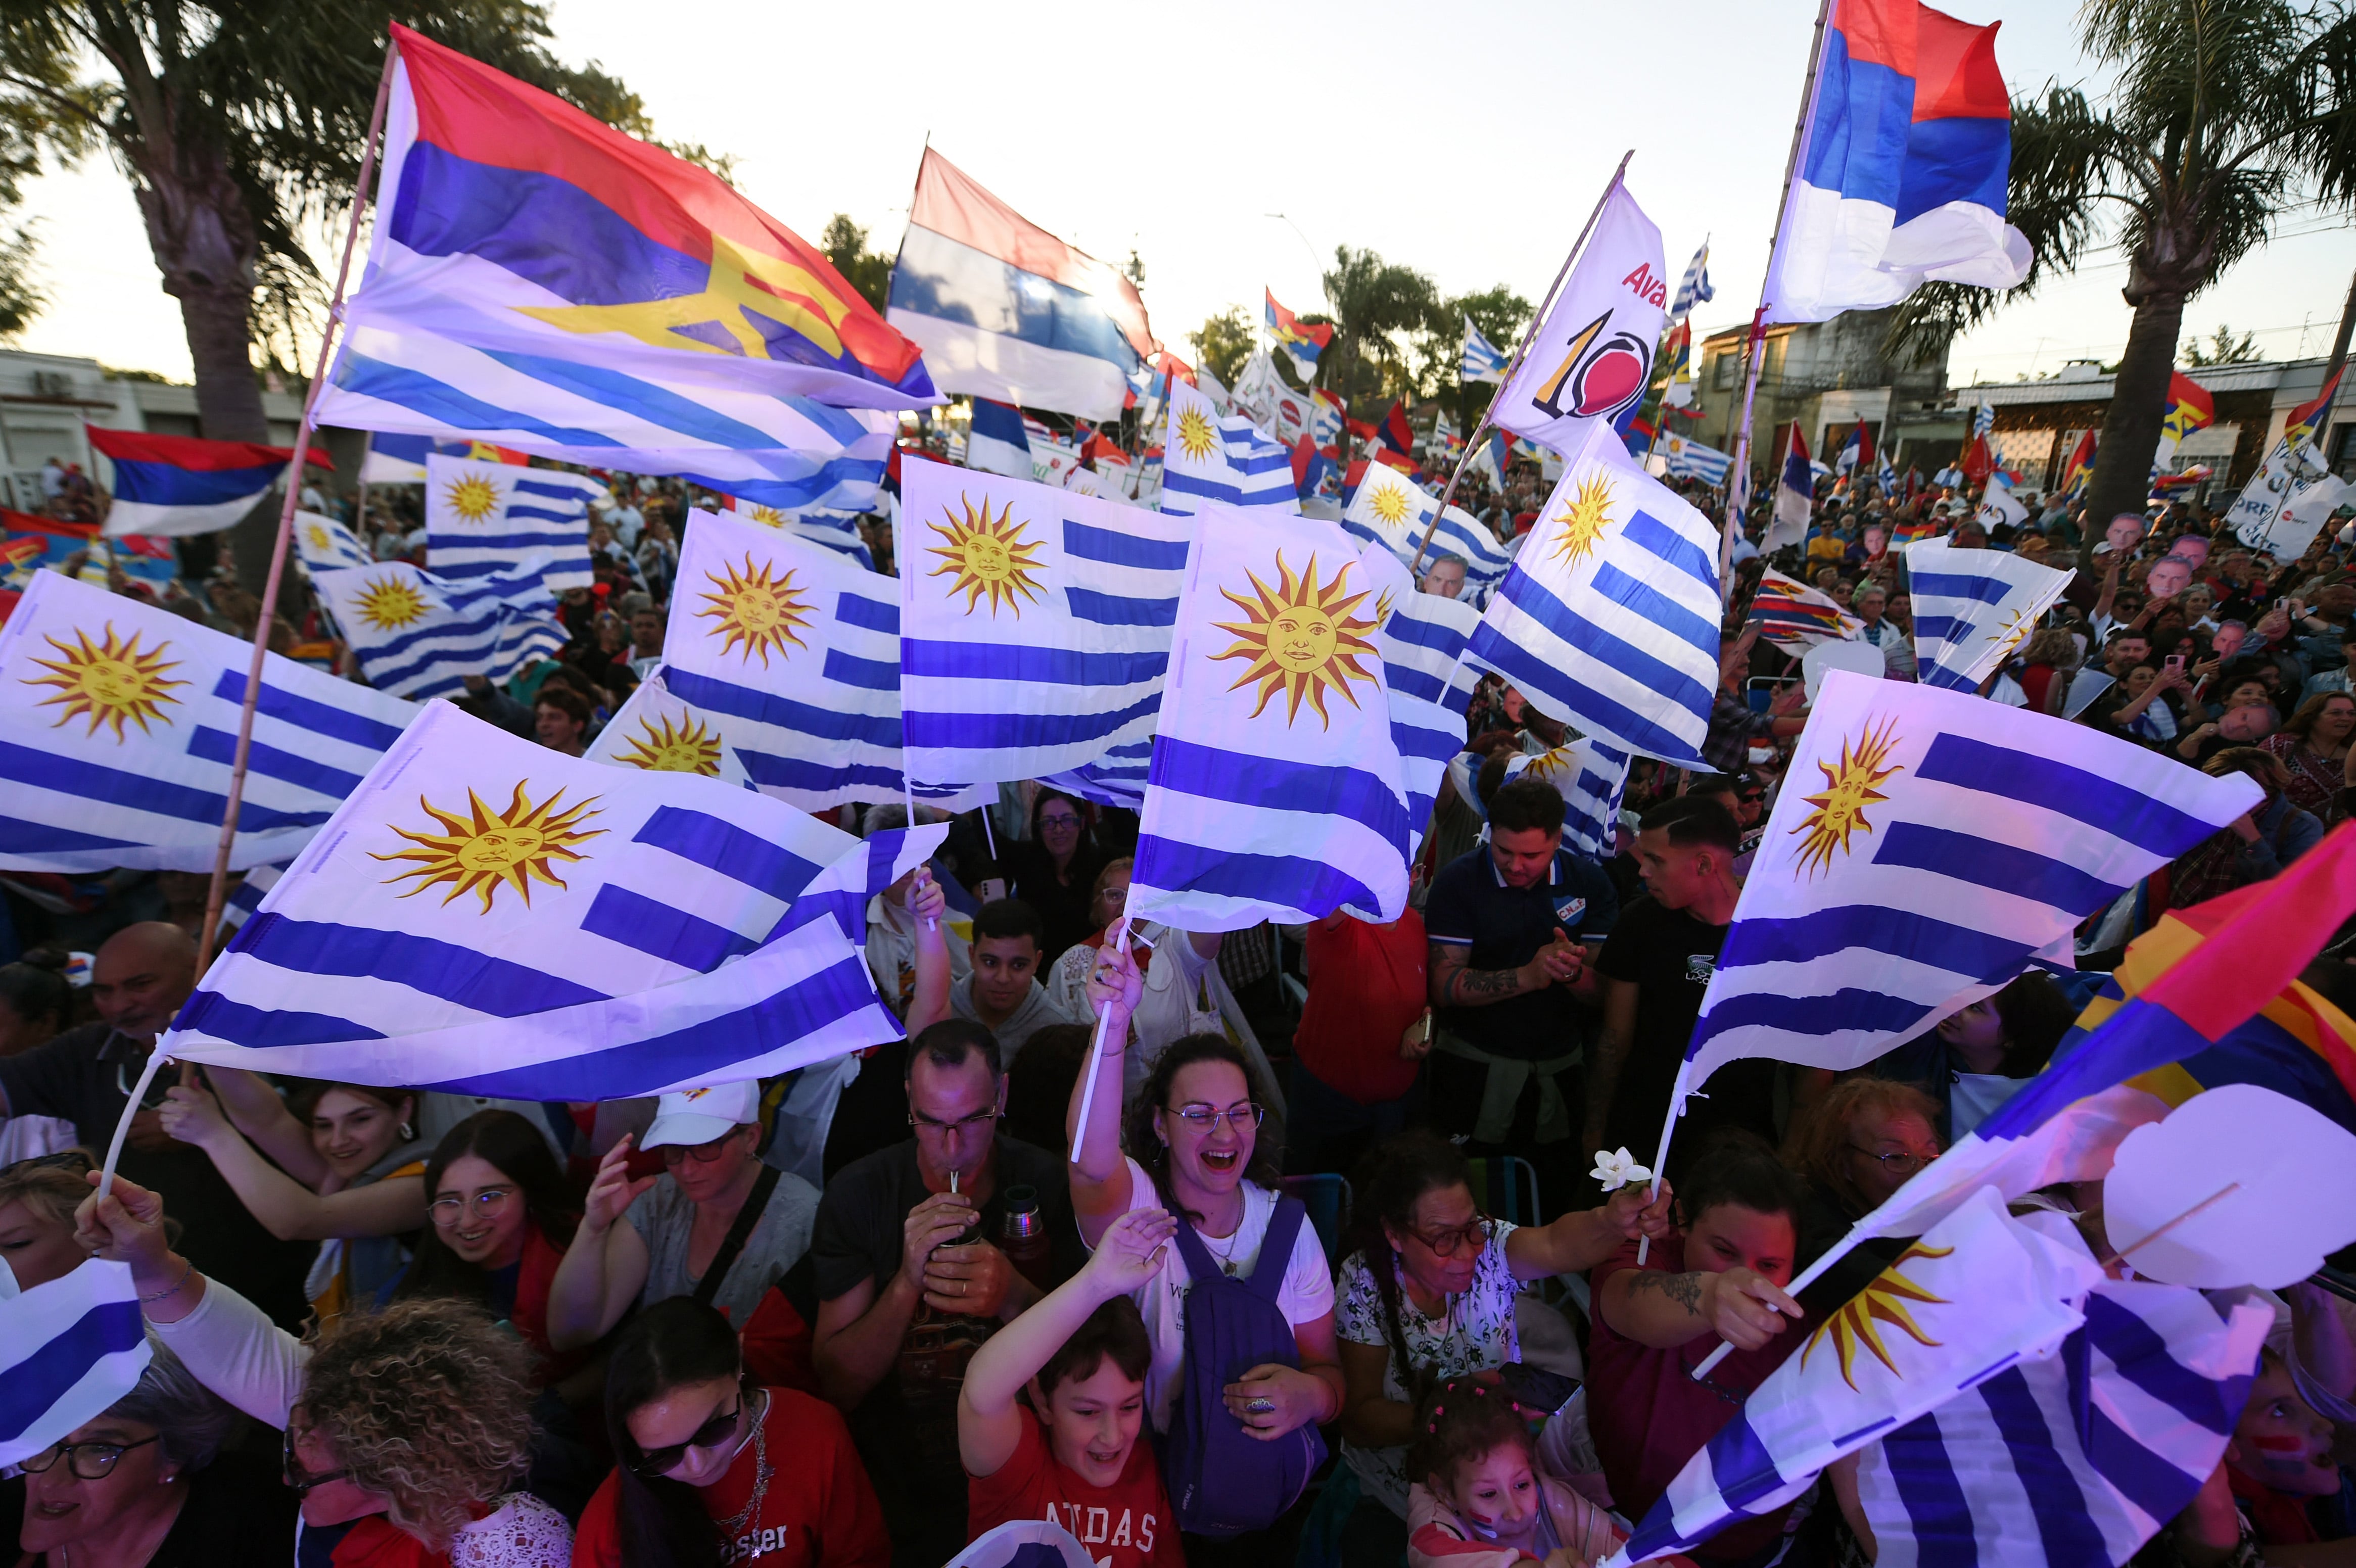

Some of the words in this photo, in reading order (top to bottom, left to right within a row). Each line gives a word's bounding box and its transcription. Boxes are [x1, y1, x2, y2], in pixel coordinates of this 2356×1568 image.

[1622, 262, 1666, 310] Ava
[1686, 972, 1710, 985] LACO
[1170, 1282, 1190, 1301] Wa
[720, 1525, 787, 1565] eser
